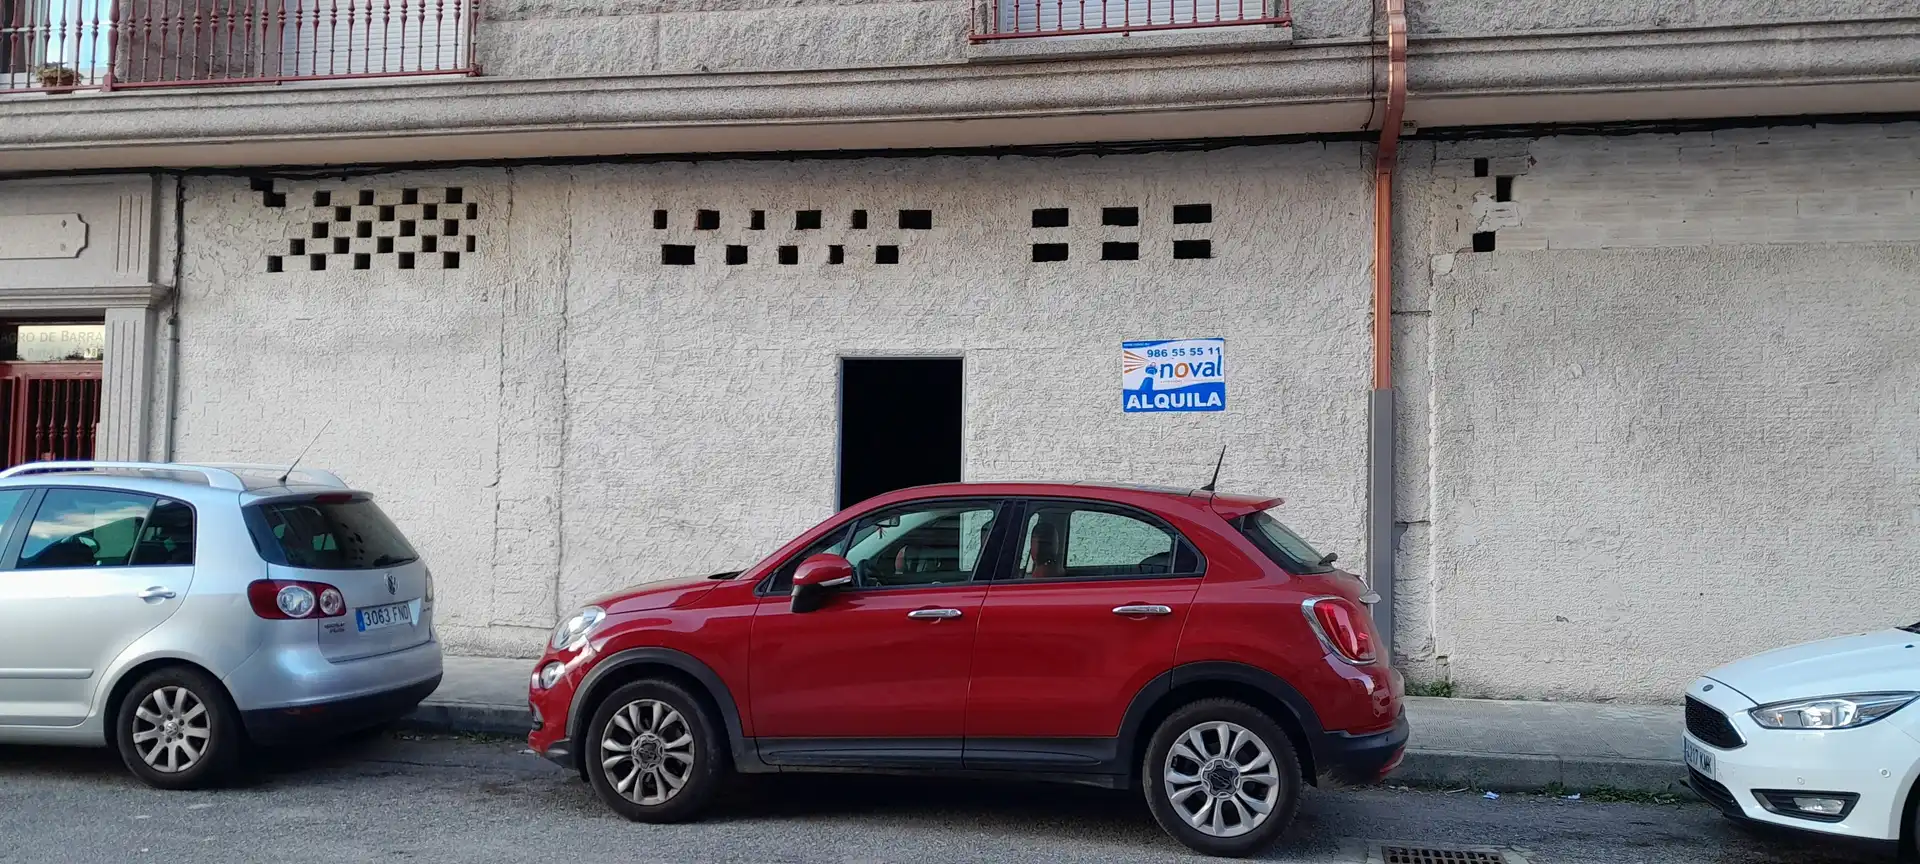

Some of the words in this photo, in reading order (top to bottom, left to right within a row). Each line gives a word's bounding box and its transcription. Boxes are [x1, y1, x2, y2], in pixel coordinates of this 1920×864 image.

[40, 331, 56, 343] DE
[1147, 349, 1168, 358] 986
[1172, 348, 1185, 357] 55
[1190, 347, 1203, 356] 55
[1208, 346, 1220, 355] 11
[1126, 392, 1222, 409] ALQUILA
[364, 607, 390, 626] 3063
